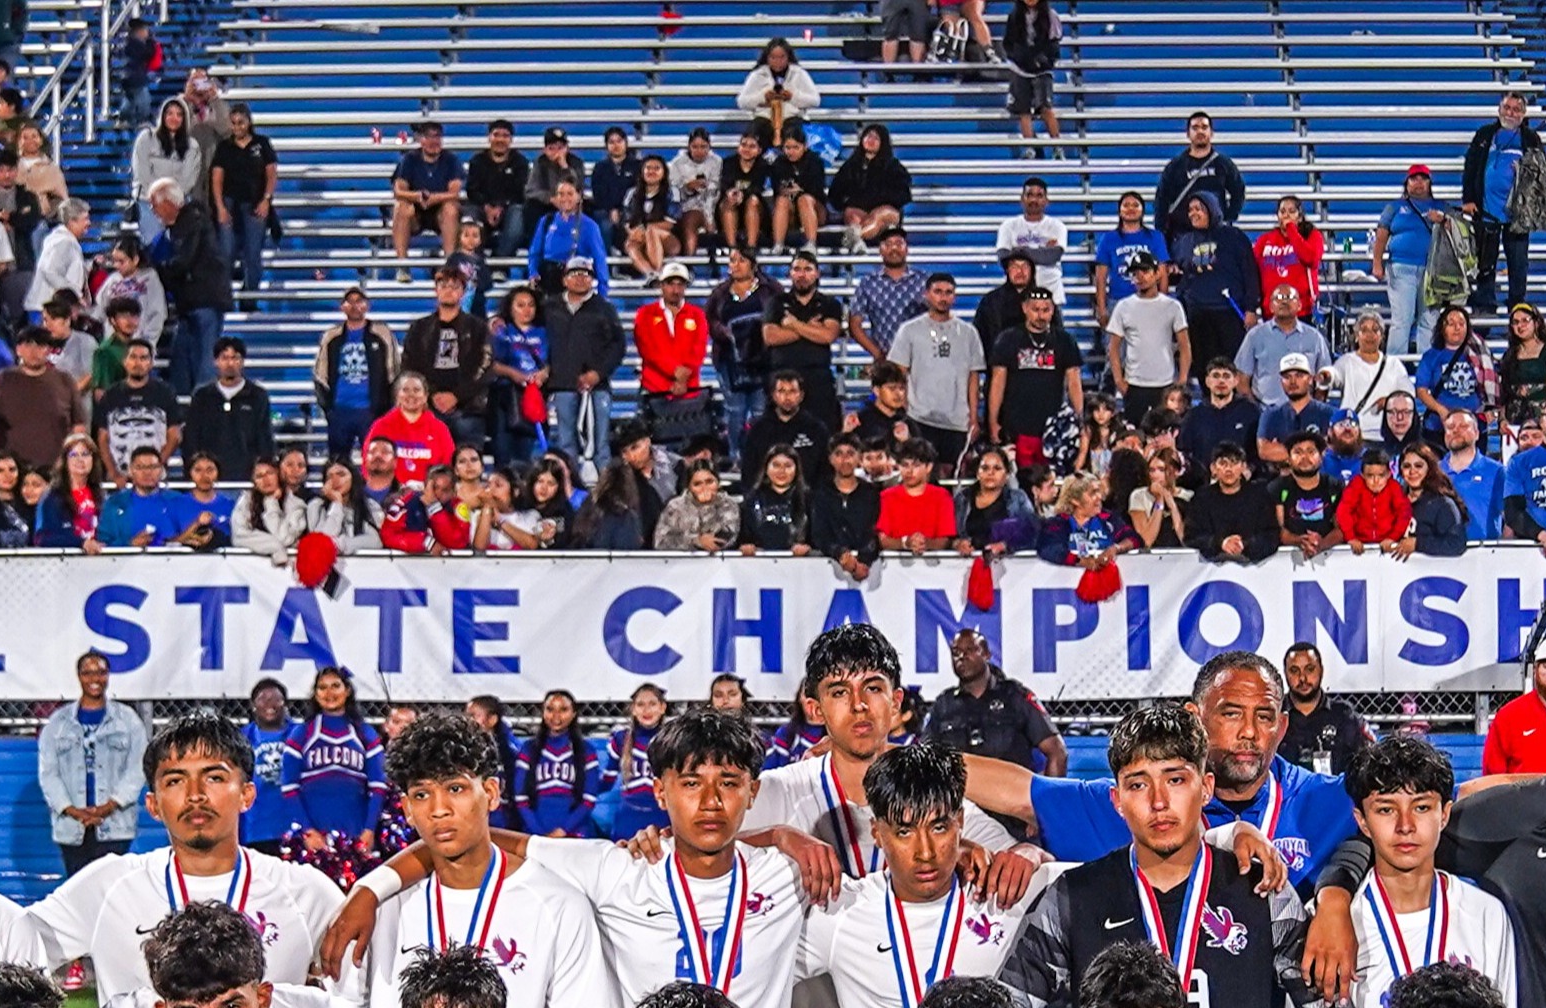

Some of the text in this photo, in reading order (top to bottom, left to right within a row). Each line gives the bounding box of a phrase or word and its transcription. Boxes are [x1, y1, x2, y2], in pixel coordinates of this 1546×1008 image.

[1262, 244, 1295, 257] ROYA
[396, 447, 432, 459] ALCONS
[83, 584, 520, 675] STATE
[308, 745, 365, 771] FALCONS
[1273, 837, 1312, 857] ROYAL
